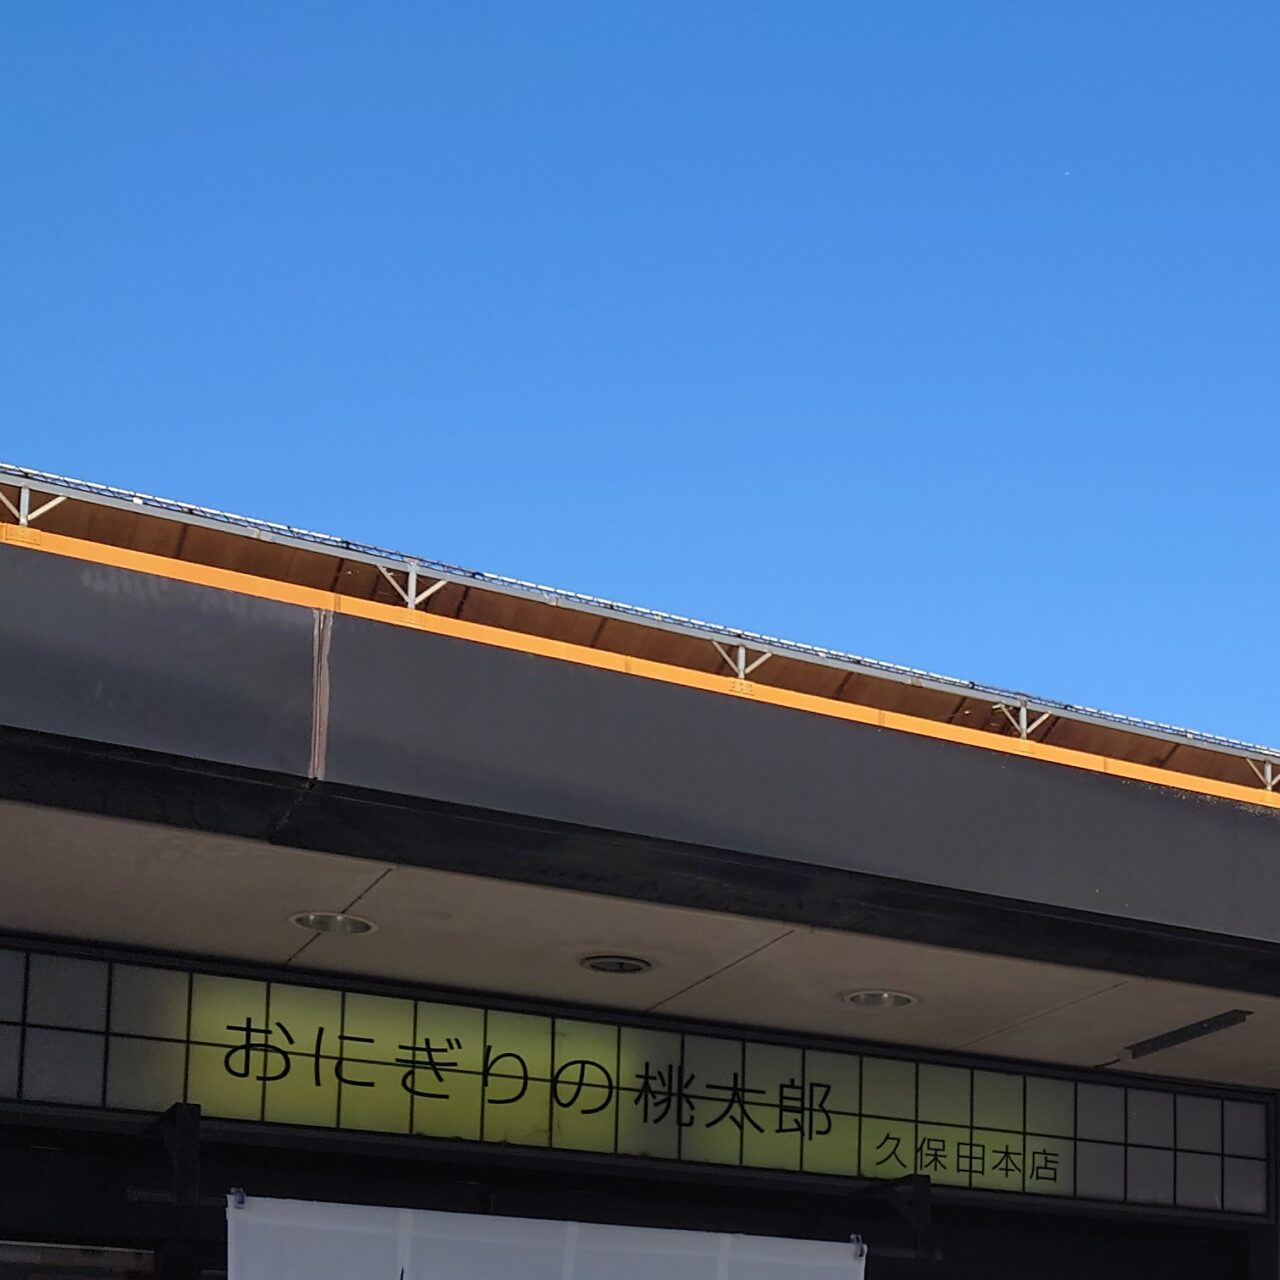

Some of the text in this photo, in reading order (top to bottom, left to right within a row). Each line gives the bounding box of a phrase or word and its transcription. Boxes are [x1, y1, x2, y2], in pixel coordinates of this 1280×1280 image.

[222, 1018, 833, 1142] おにぎりの桃太郎
[874, 1131, 1060, 1184] 久保田本店
